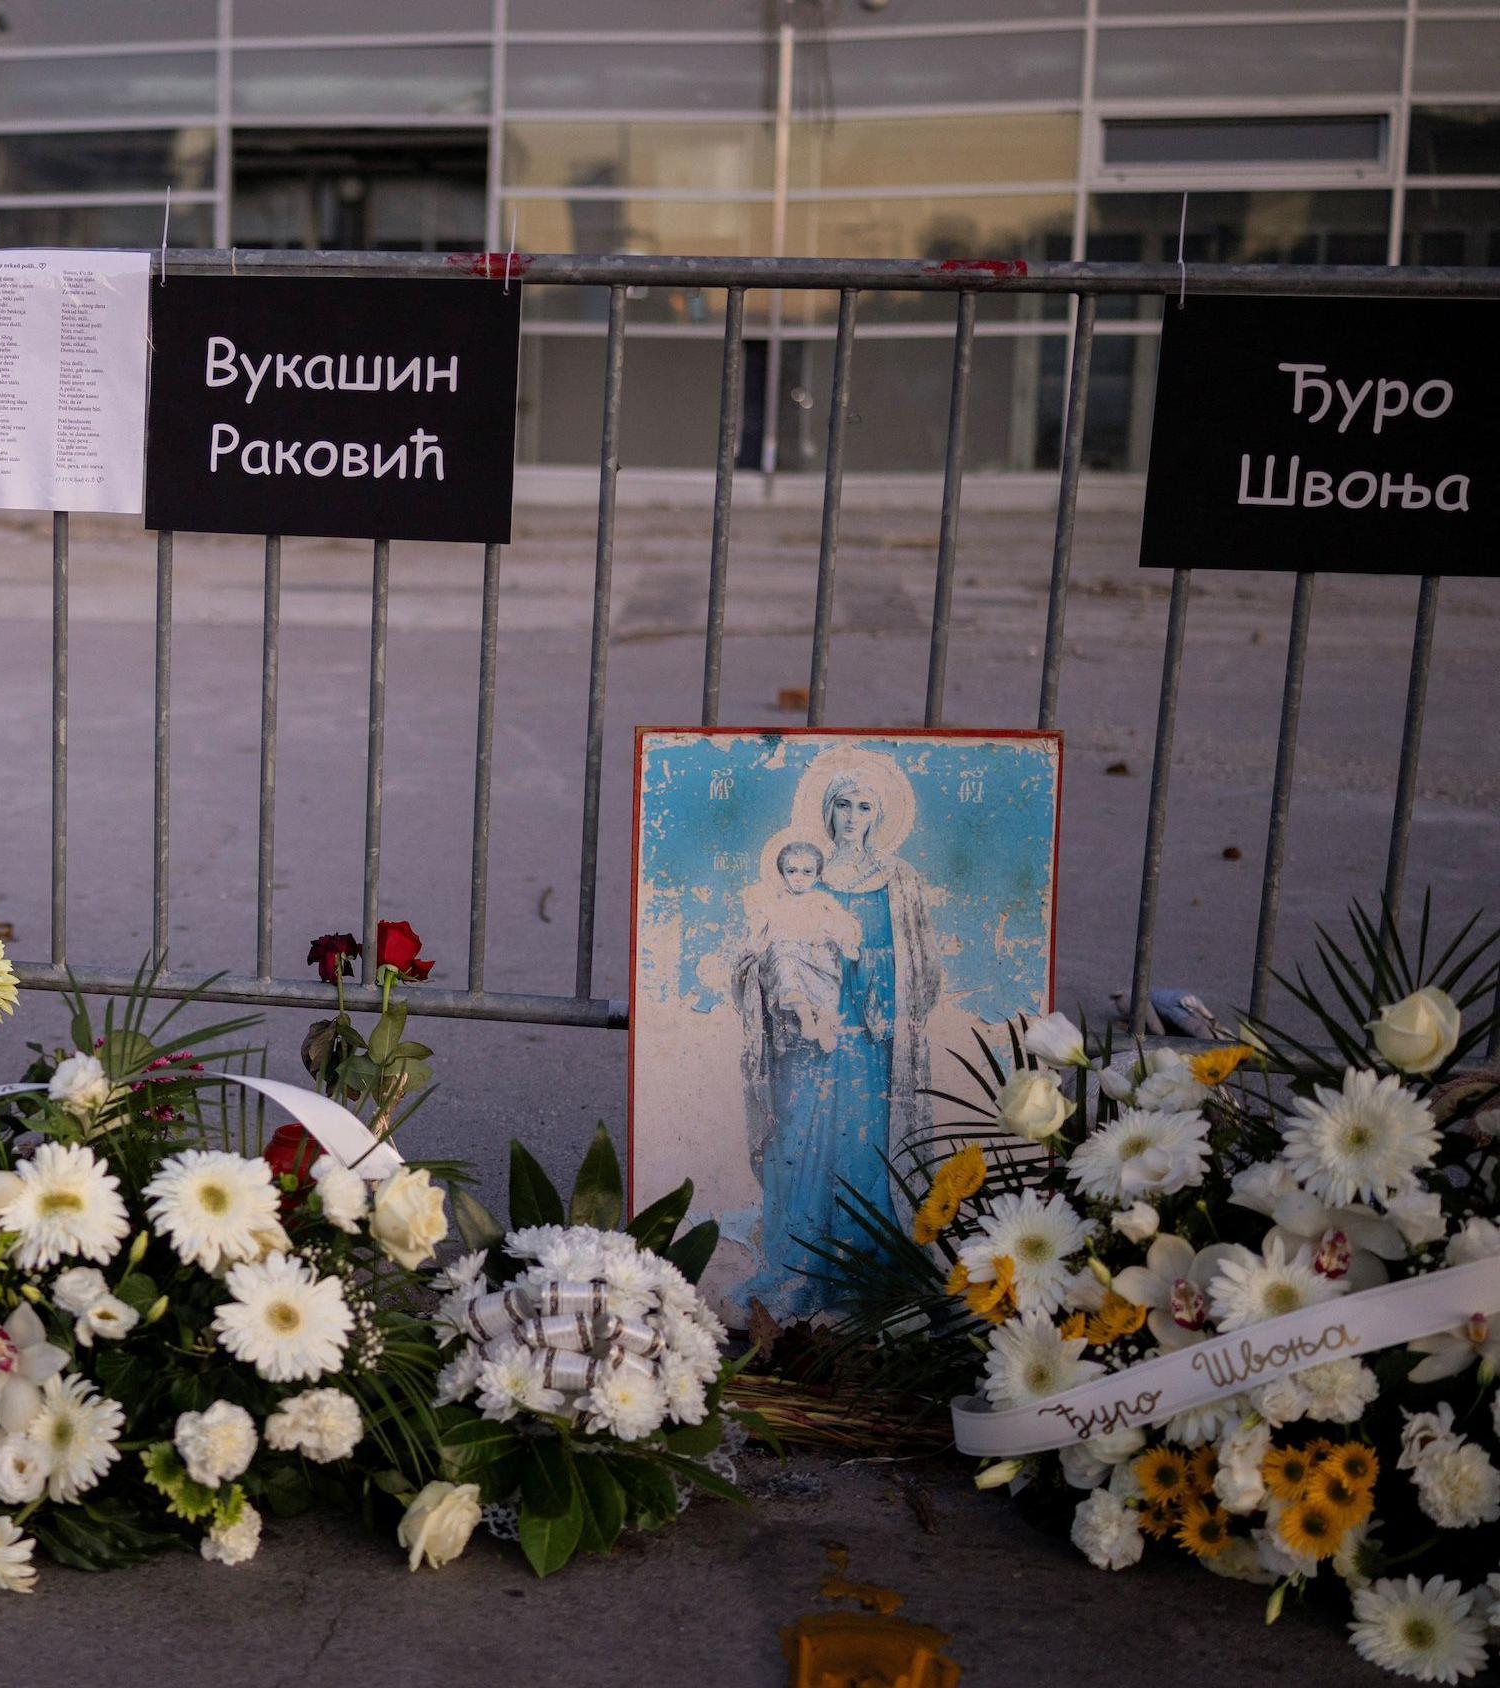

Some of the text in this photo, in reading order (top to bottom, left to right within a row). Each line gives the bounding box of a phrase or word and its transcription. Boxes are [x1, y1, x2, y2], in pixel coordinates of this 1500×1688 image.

[205, 336, 458, 404] Вукашин
[1278, 362, 1454, 434] Ђуро
[210, 423, 445, 481] Раковић
[1237, 453, 1471, 512] Швоња
[1038, 1323, 1361, 1439] Ђуро Швоња
